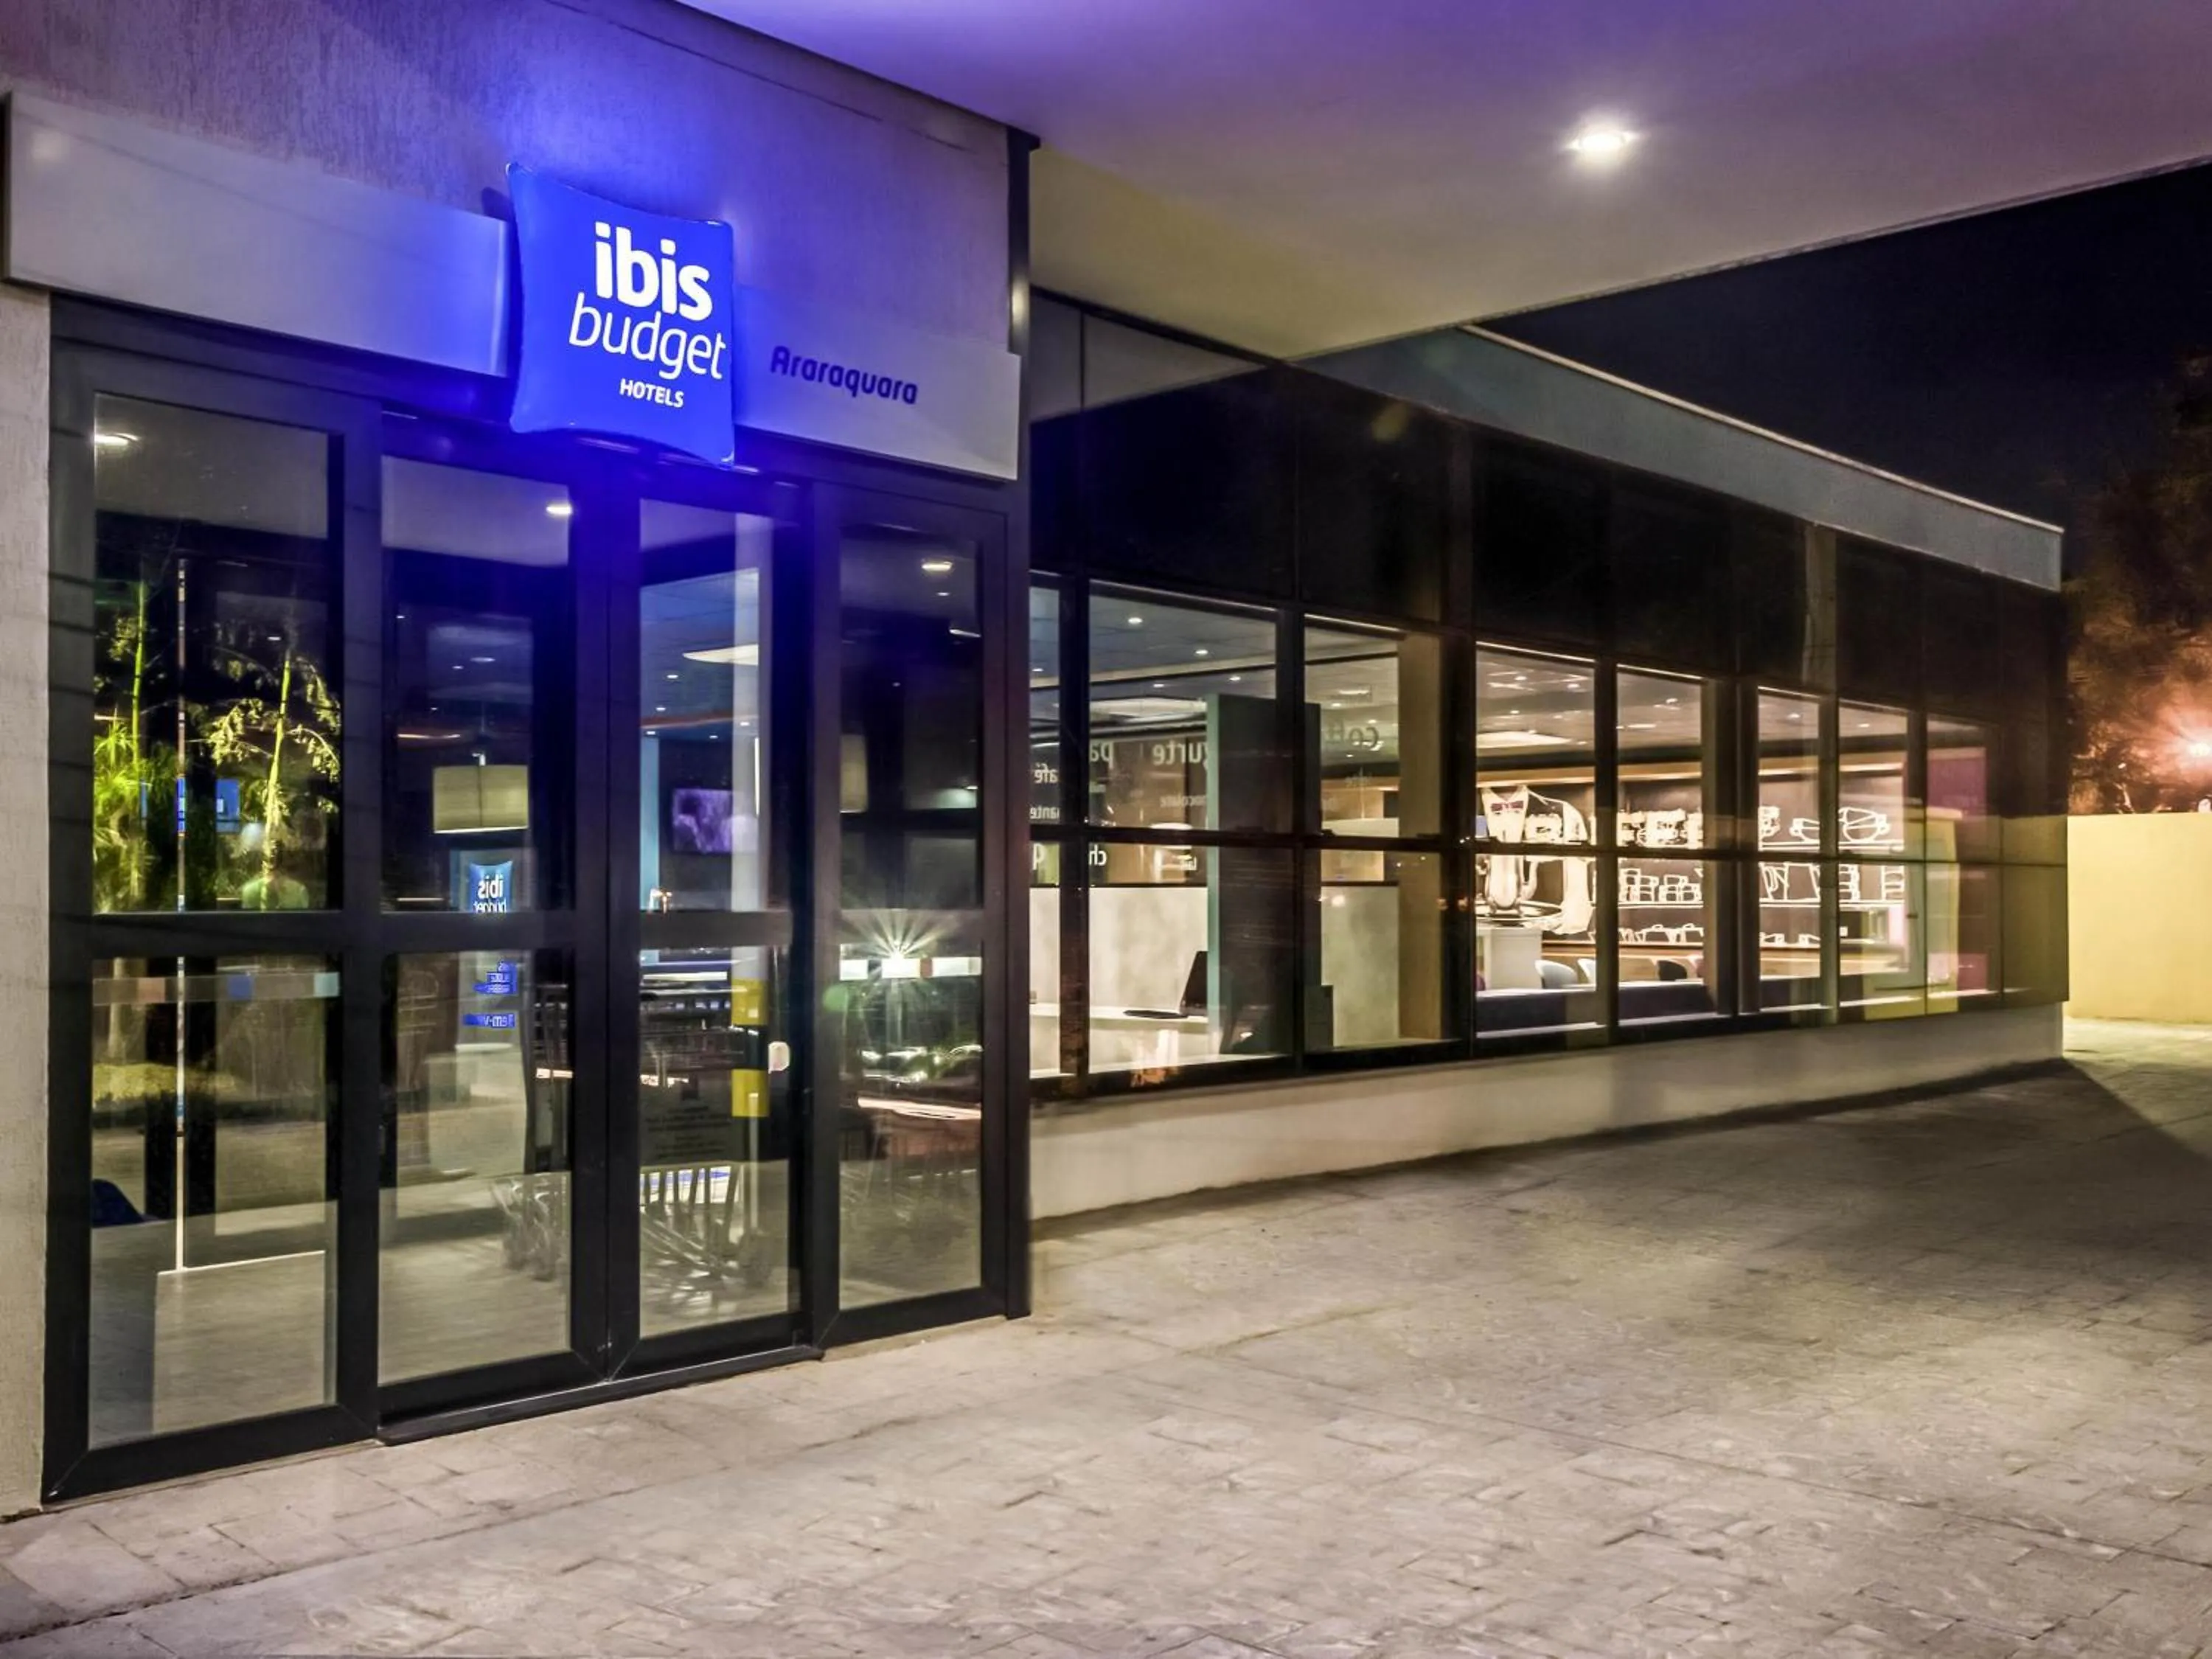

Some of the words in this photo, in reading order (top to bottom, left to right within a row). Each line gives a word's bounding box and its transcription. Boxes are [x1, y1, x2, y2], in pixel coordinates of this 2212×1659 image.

[594, 220, 713, 321] ibis
[568, 292, 726, 380] budget
[619, 378, 684, 408] HOTELS
[770, 345, 919, 406] Araraquara
